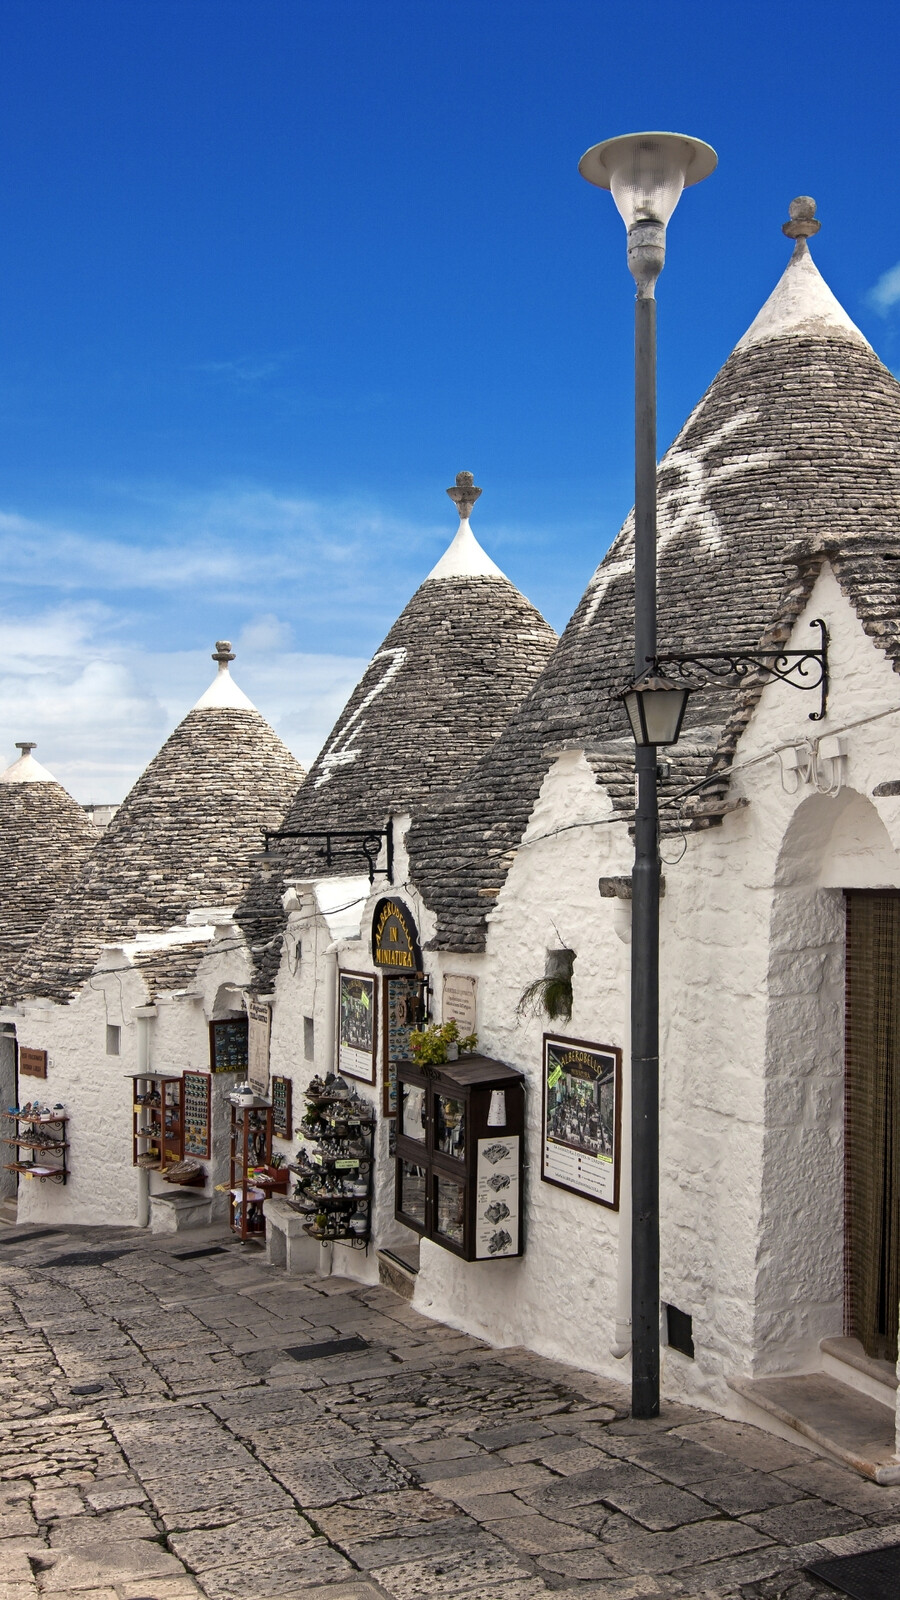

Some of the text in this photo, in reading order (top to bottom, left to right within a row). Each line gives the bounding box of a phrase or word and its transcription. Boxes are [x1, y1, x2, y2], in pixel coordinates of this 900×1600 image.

[389, 926, 398, 942] IN
[376, 949, 412, 967] MINIATURA
[561, 1050, 602, 1075] ALBEROBELLO
